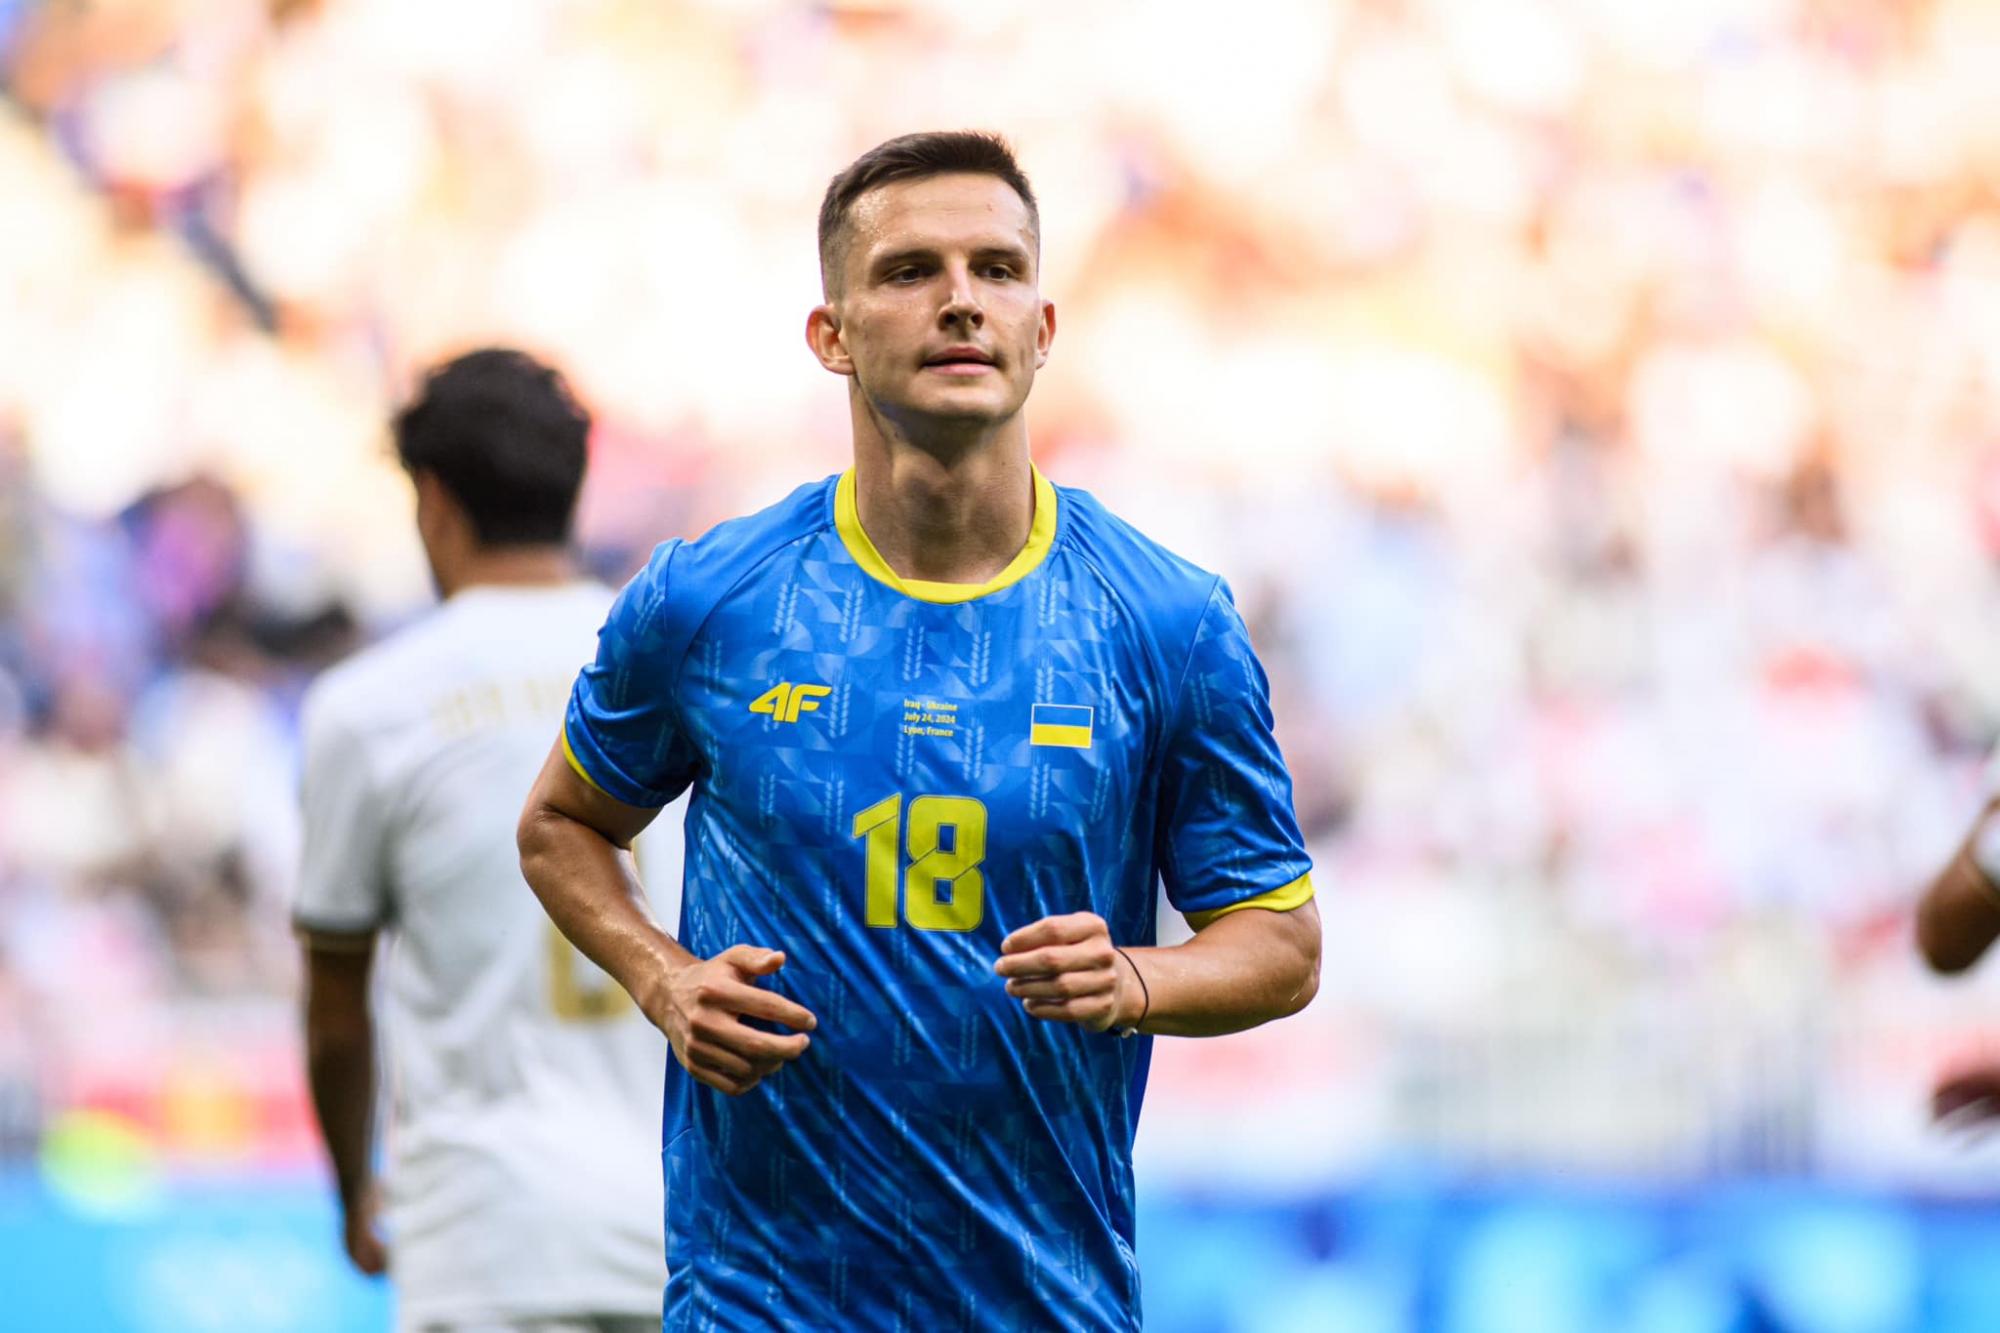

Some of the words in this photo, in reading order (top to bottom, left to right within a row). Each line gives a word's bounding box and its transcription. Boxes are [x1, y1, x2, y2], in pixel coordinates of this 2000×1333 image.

[749, 682, 832, 722] 4F
[904, 698, 920, 710] Iraq
[927, 700, 957, 711] Ukraine
[904, 712, 920, 723] July
[922, 713, 934, 723] 24,
[936, 714, 956, 723] 2024
[904, 725, 925, 736] Lyon,
[927, 727, 953, 736] France
[853, 793, 987, 932] 18
